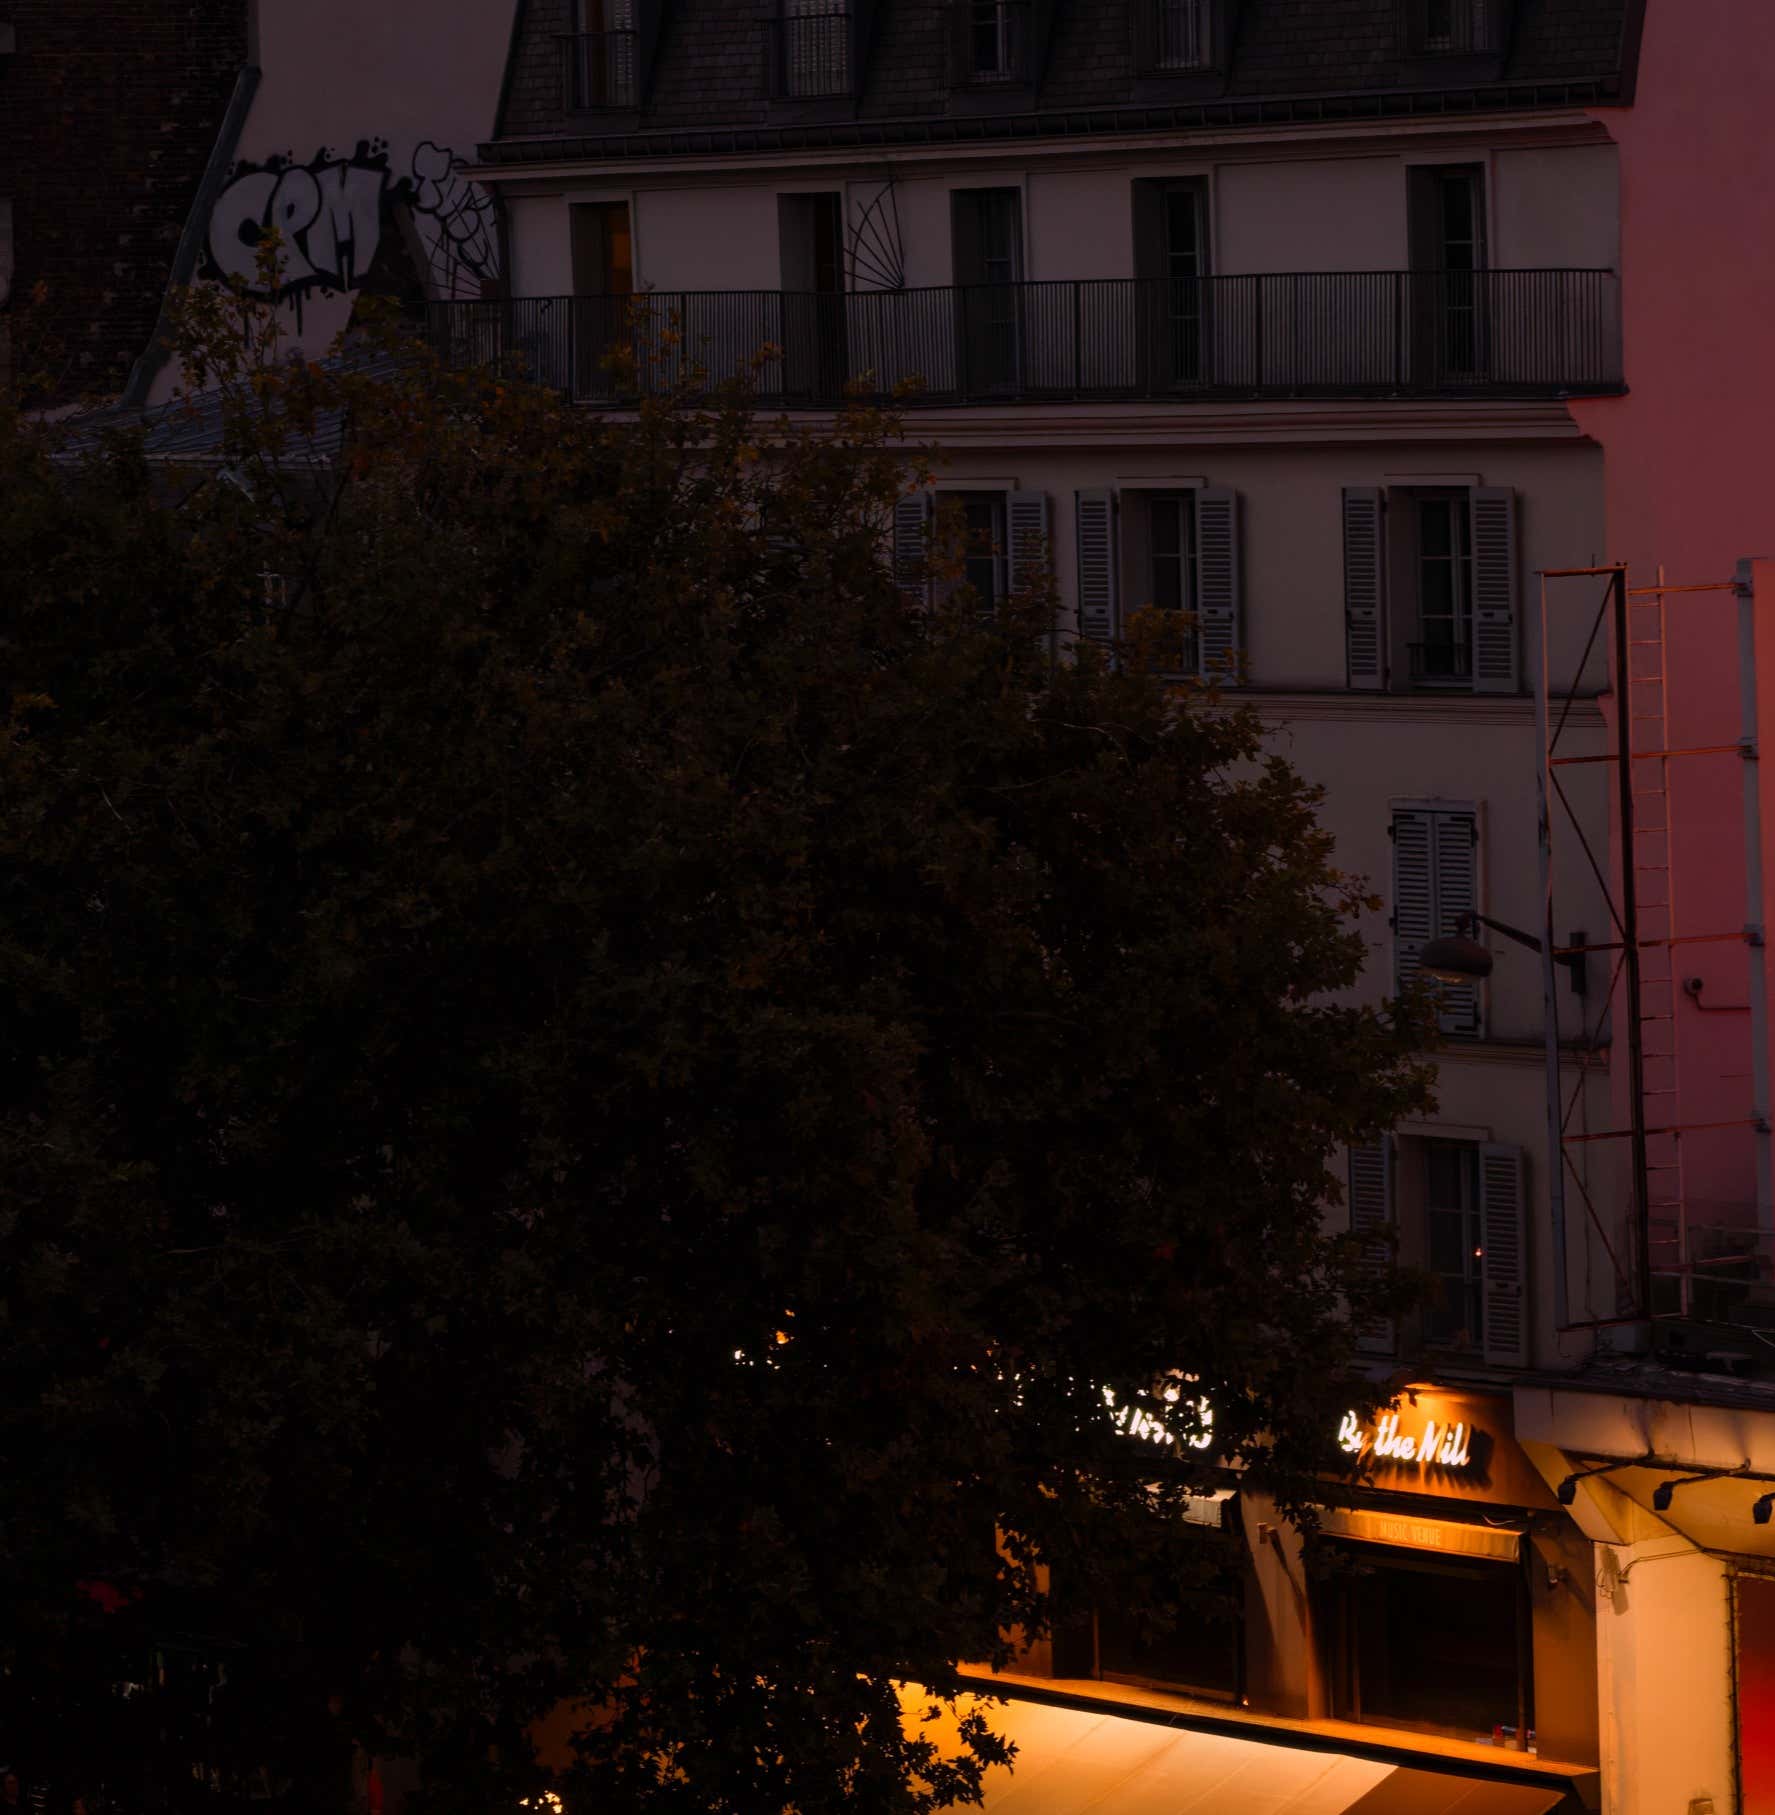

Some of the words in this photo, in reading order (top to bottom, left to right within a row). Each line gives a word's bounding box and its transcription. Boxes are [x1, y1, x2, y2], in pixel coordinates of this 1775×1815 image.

[1374, 1414, 1416, 1460] the
[1416, 1420, 1471, 1467] Mill
[1410, 1525, 1442, 1546] VENUE
